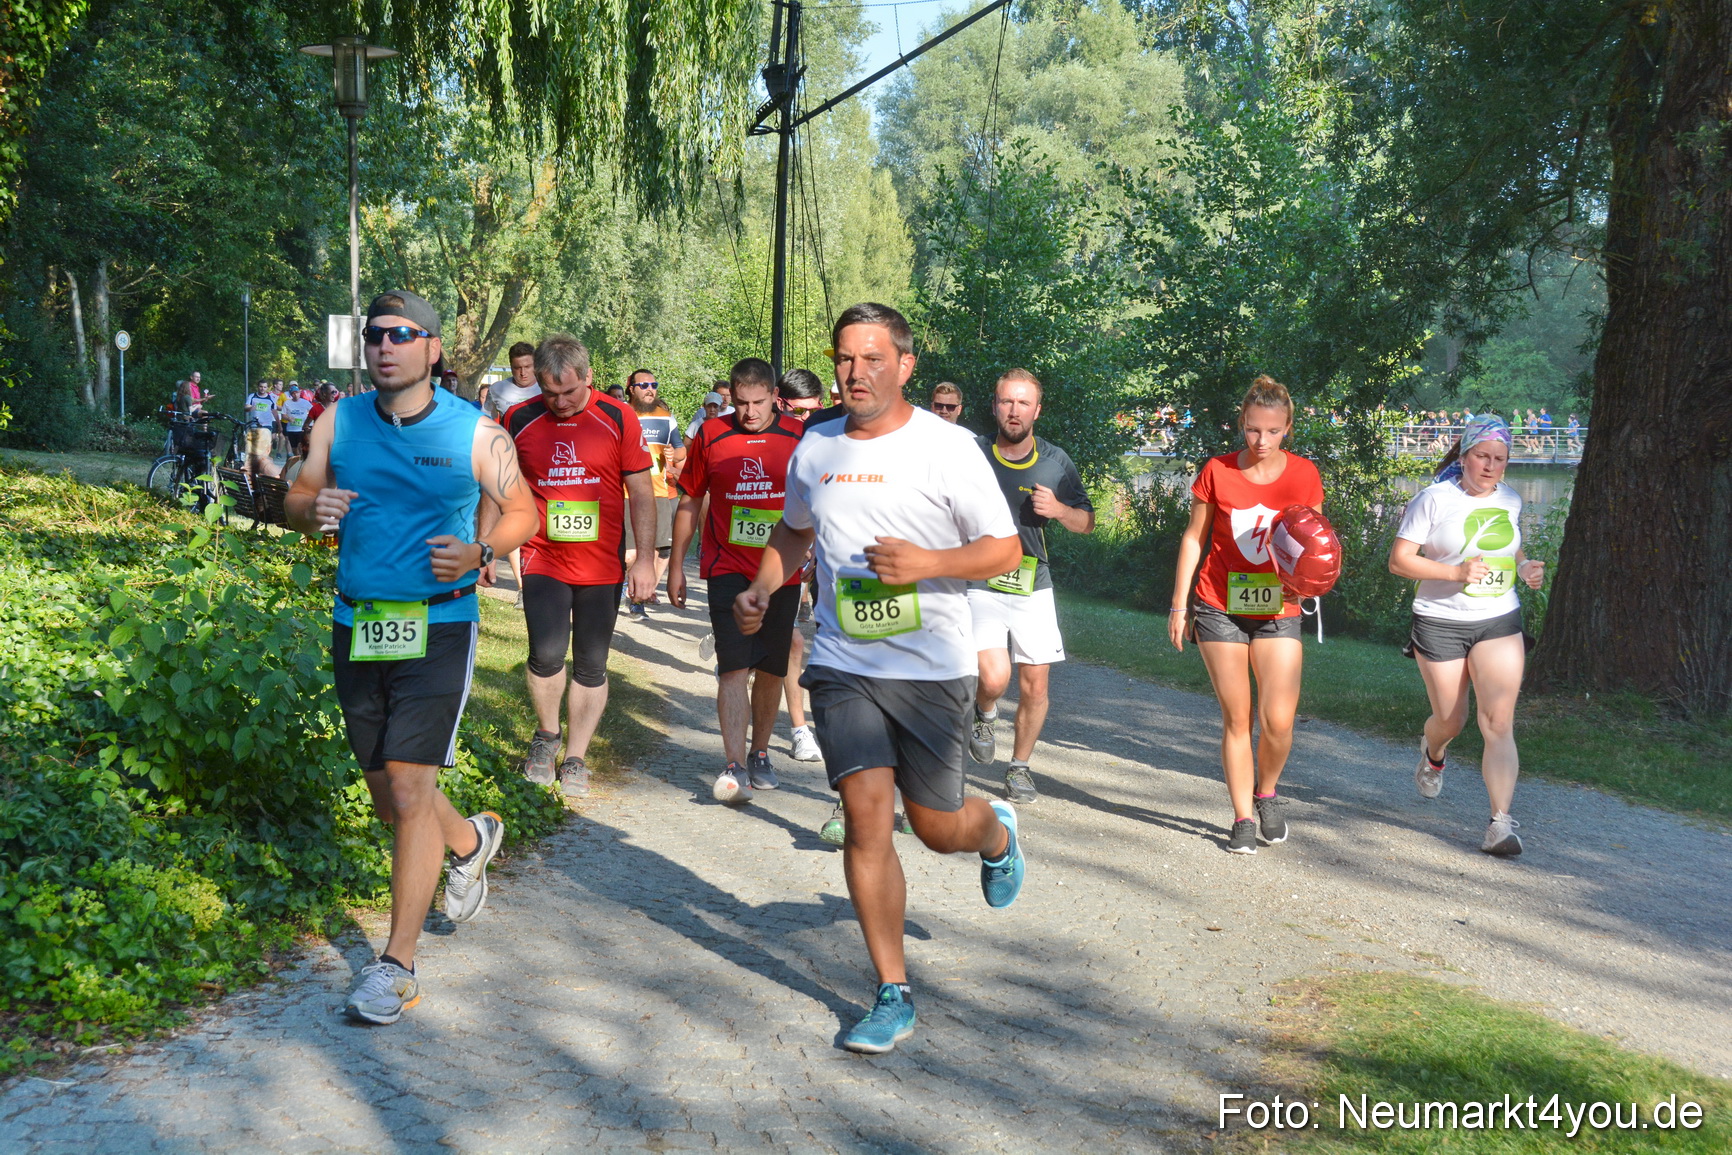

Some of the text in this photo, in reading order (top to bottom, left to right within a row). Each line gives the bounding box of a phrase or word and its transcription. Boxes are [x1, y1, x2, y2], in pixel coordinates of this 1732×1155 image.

[413, 456, 453, 468] THULE
[548, 467, 586, 477] MEYER
[836, 474, 888, 483] KLEBL
[736, 482, 773, 491] MEYER
[726, 492, 768, 500] Fördertechnik
[553, 515, 592, 530] 1359
[1239, 588, 1272, 603] 410
[854, 598, 900, 622] 886
[361, 621, 416, 643] 1935
